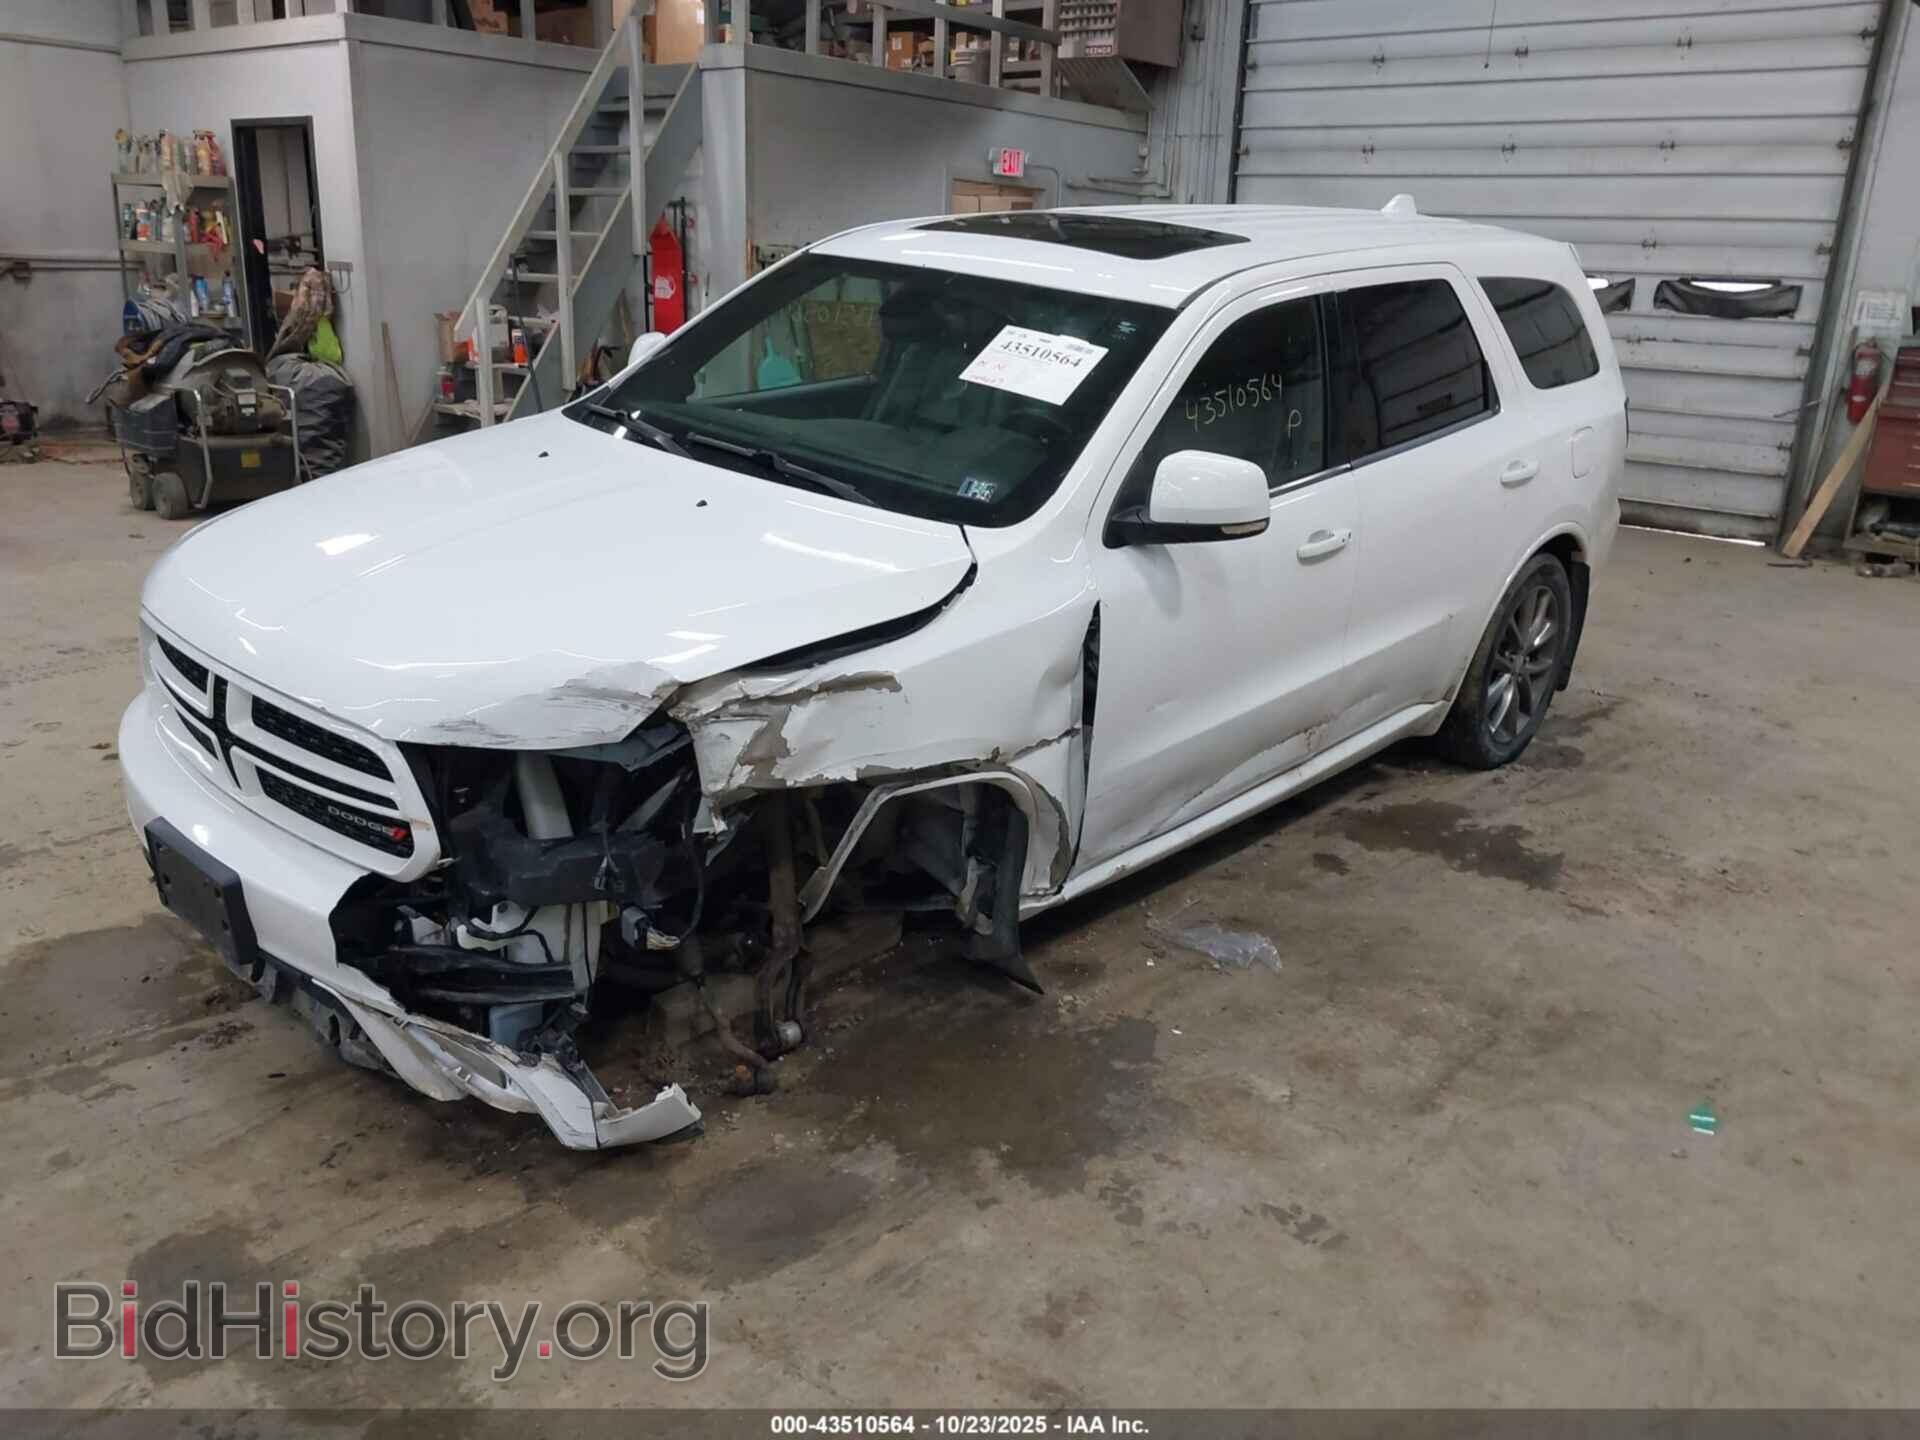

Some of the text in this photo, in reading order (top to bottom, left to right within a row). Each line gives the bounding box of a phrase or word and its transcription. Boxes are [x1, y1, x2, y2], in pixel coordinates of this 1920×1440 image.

[1000, 339, 1083, 368] 43510564
[1185, 373, 1283, 432] 43510564
[327, 805, 394, 836] DODGE
